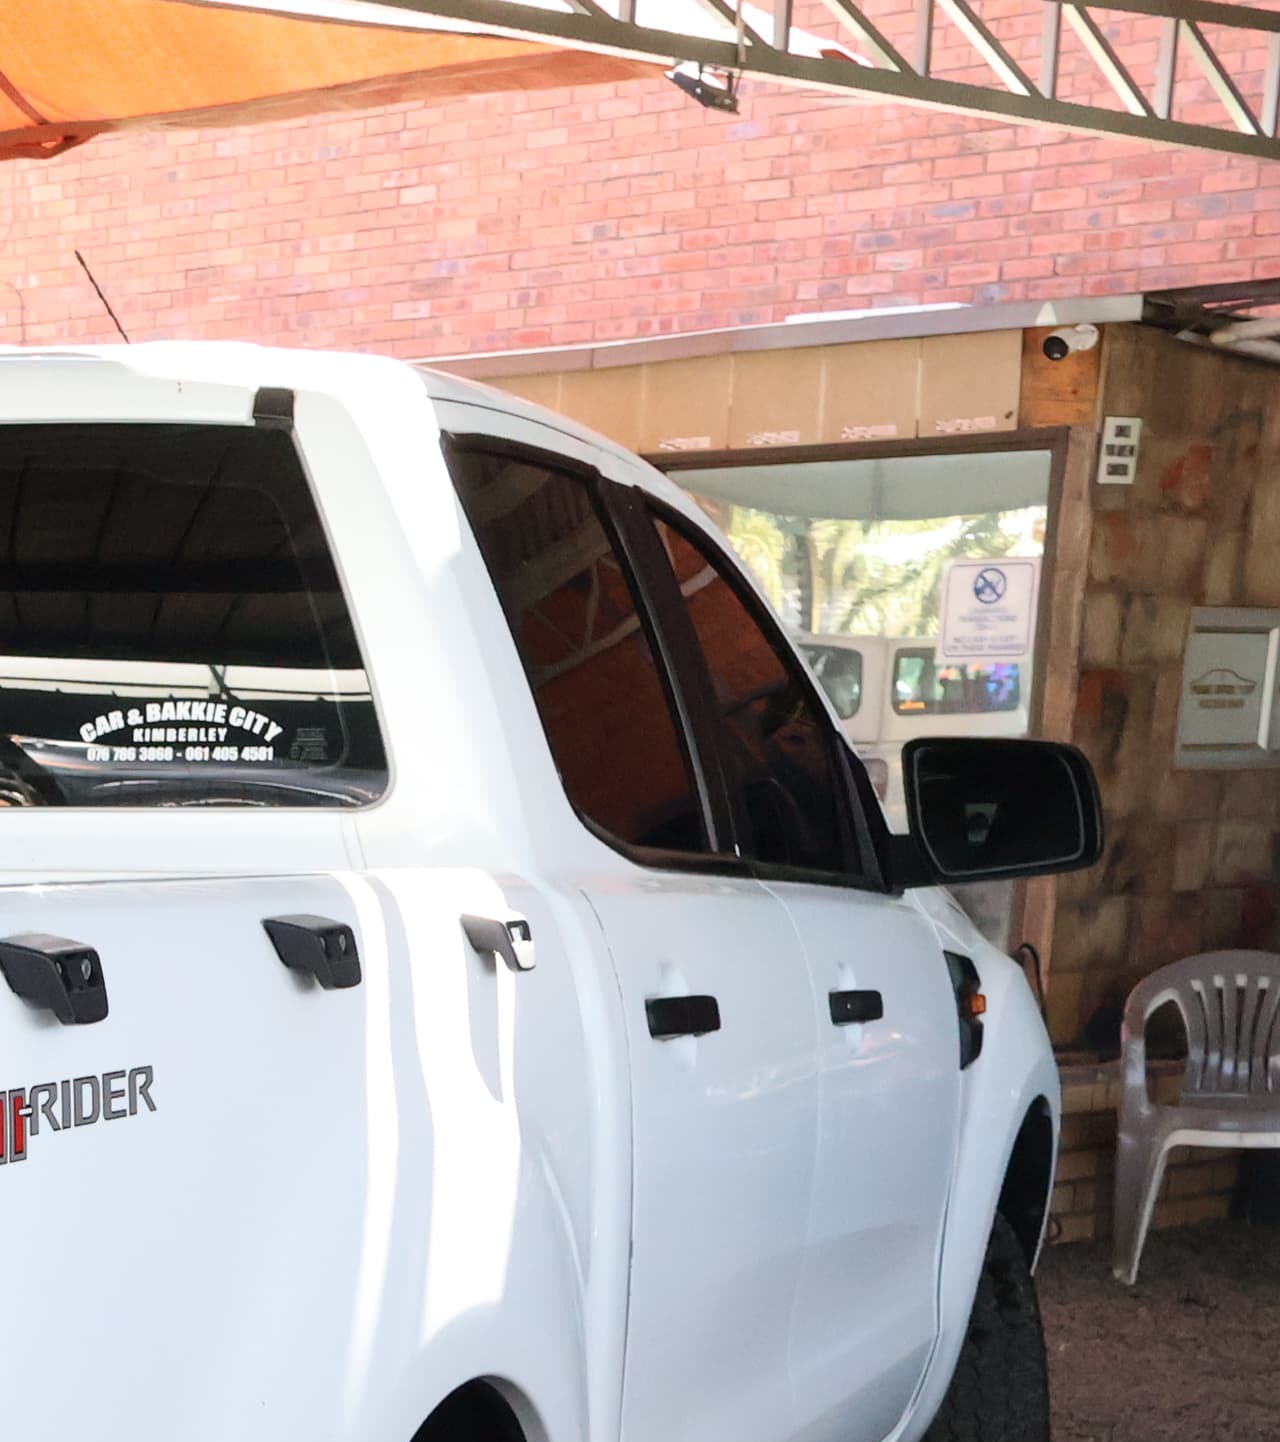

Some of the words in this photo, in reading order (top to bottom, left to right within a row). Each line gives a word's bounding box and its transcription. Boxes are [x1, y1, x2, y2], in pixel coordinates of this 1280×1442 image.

[79, 710, 125, 743] CAR
[127, 708, 144, 726] &
[145, 701, 228, 724] BAKKIE
[228, 706, 284, 742] CITY
[133, 727, 228, 743] KIMBERLEY
[212, 746, 238, 761] 405
[241, 746, 274, 761] 4581
